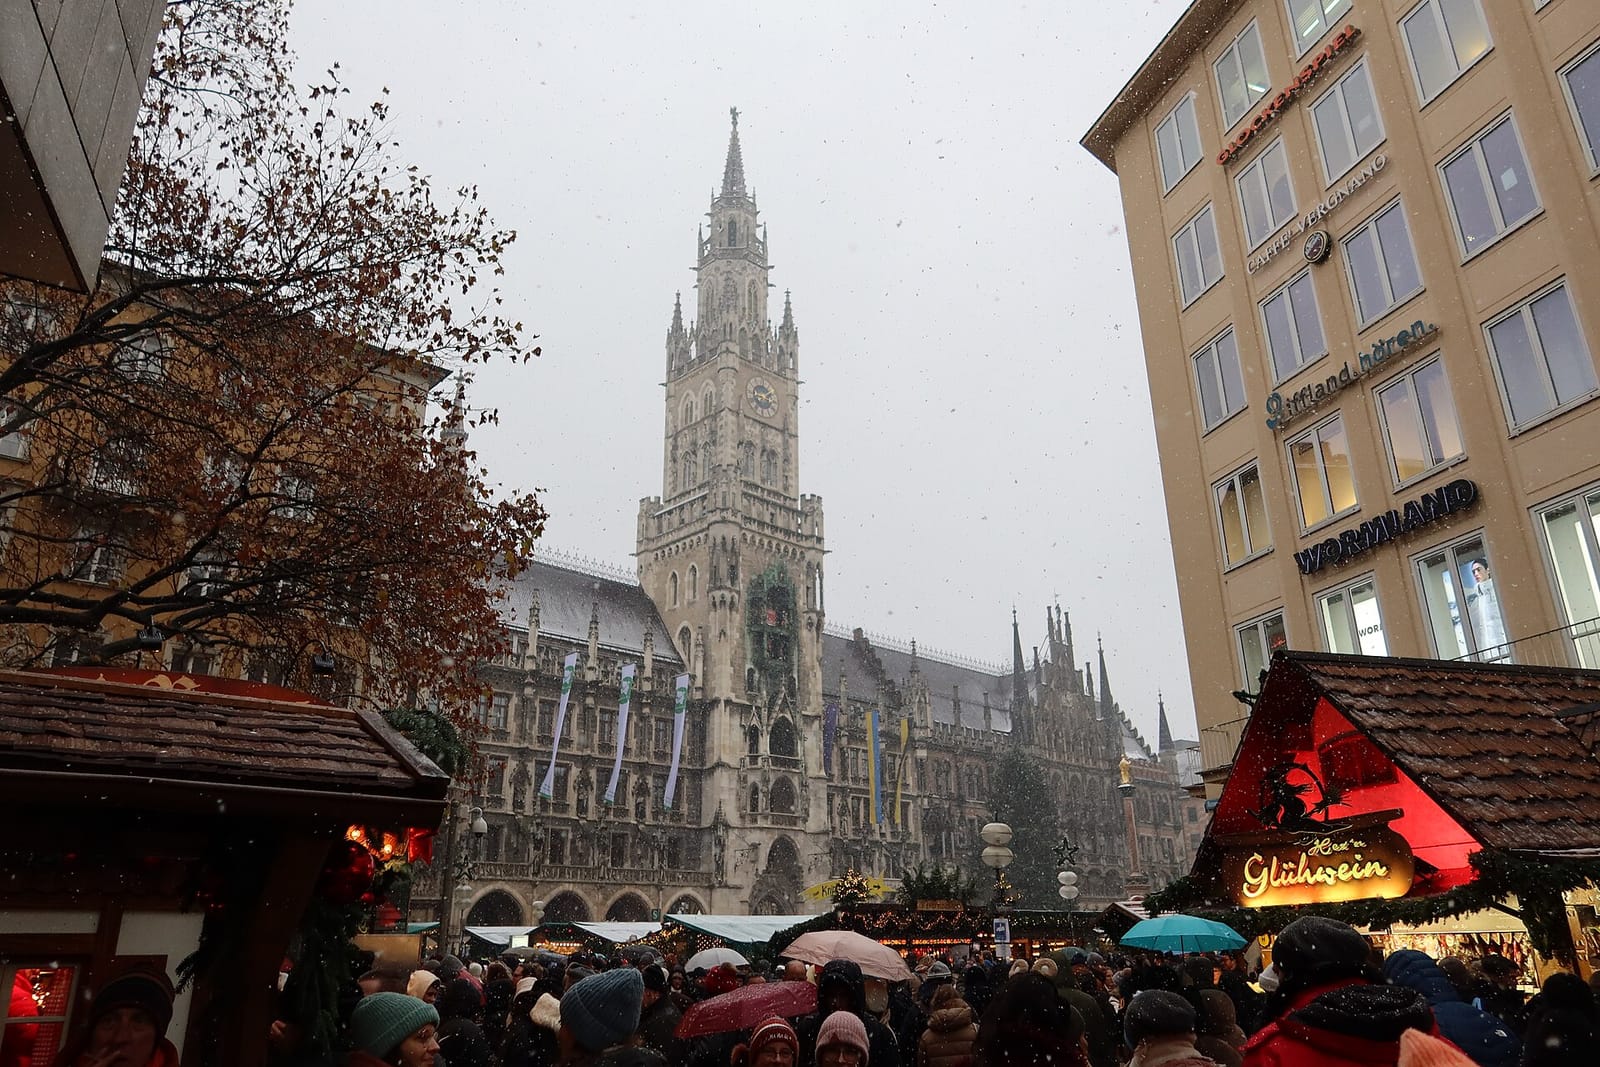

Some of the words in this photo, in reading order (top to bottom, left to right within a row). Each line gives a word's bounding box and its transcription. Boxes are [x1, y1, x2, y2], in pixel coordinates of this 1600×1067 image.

[1216, 24, 1360, 166] GLOCKENSPIEL
[1297, 154, 1387, 233] VERGNANO
[1293, 478, 1478, 575] WORMLAND
[1358, 624, 1382, 637] WOR
[1242, 852, 1389, 898] Glühwein
